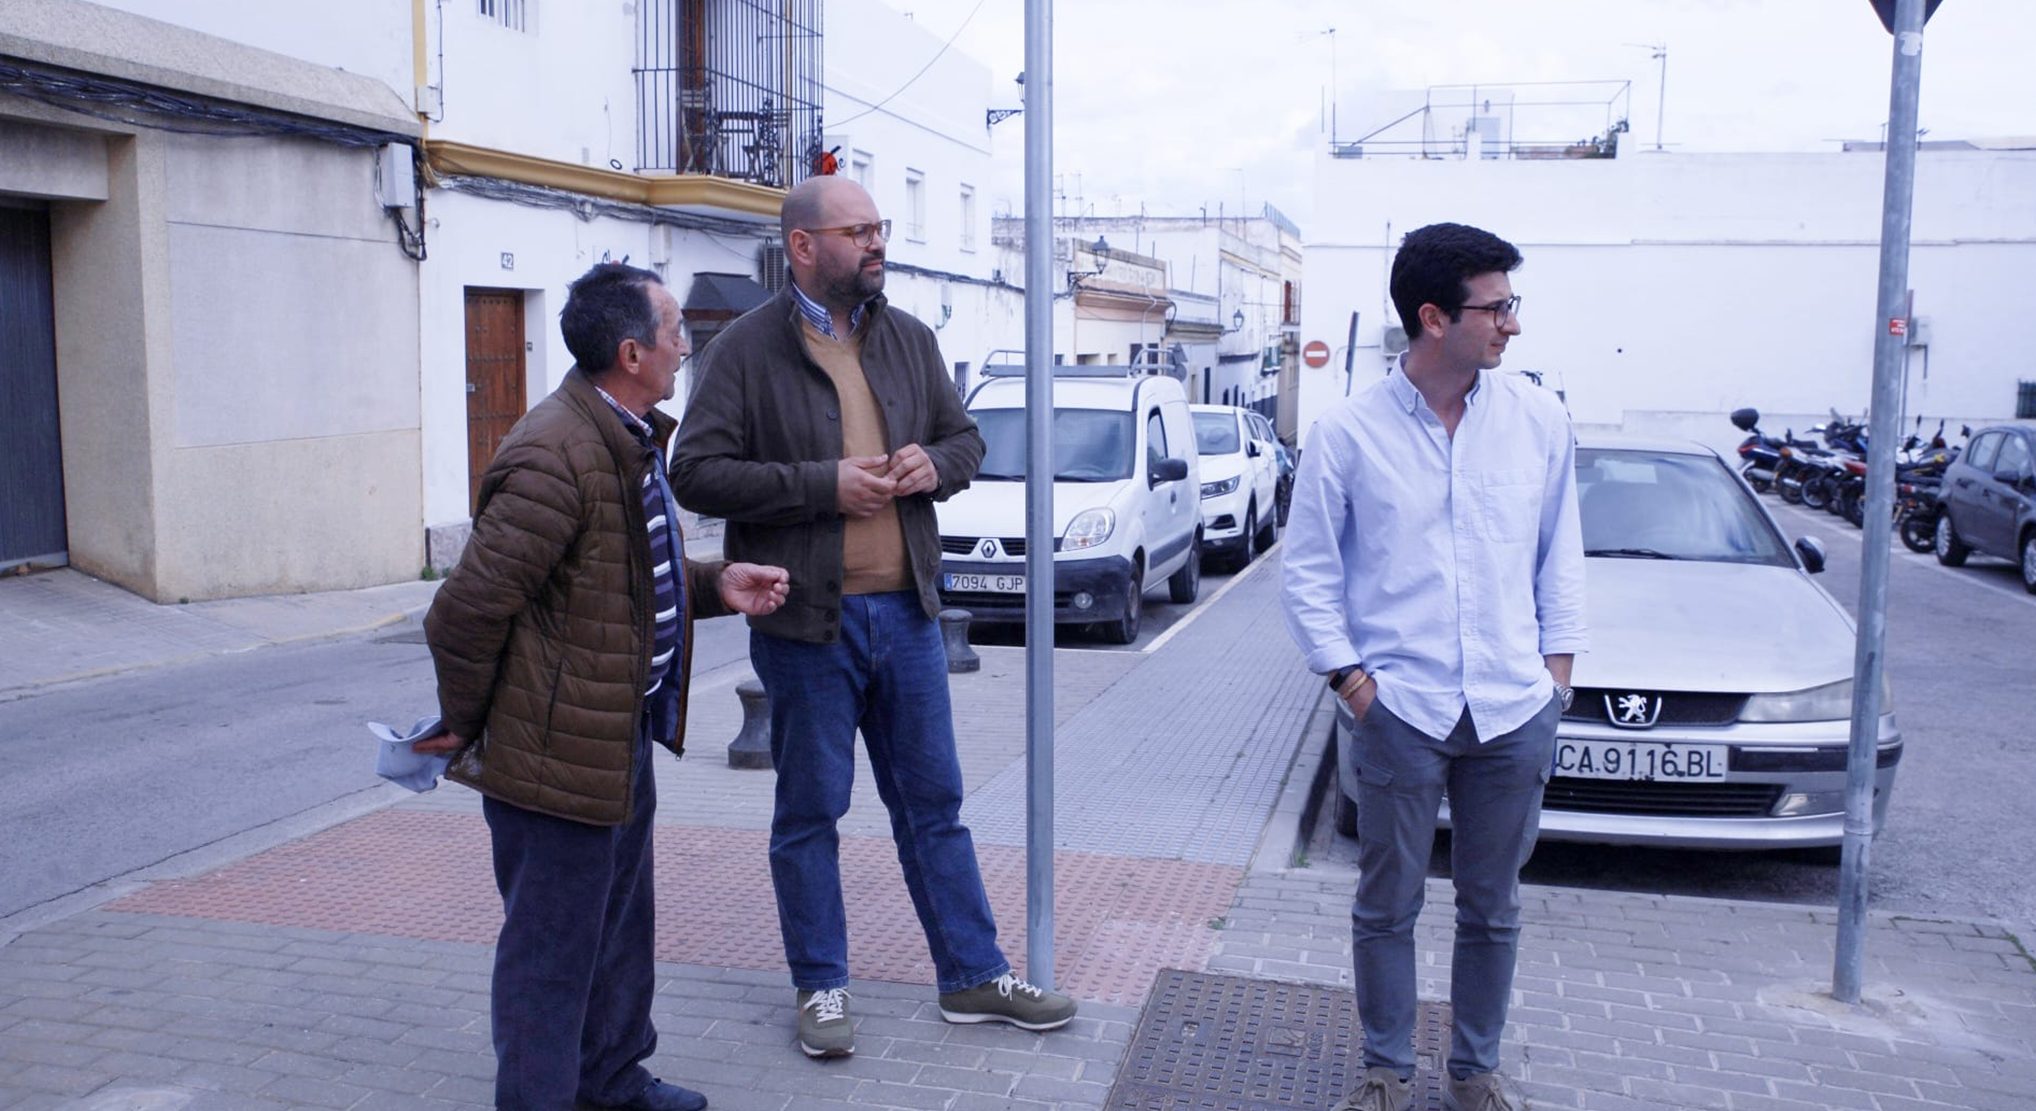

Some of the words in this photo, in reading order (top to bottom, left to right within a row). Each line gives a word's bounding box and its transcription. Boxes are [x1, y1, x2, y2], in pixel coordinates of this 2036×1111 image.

[502, 253, 514, 268] 42
[952, 575, 988, 590] 7094
[996, 576, 1024, 591] GJP
